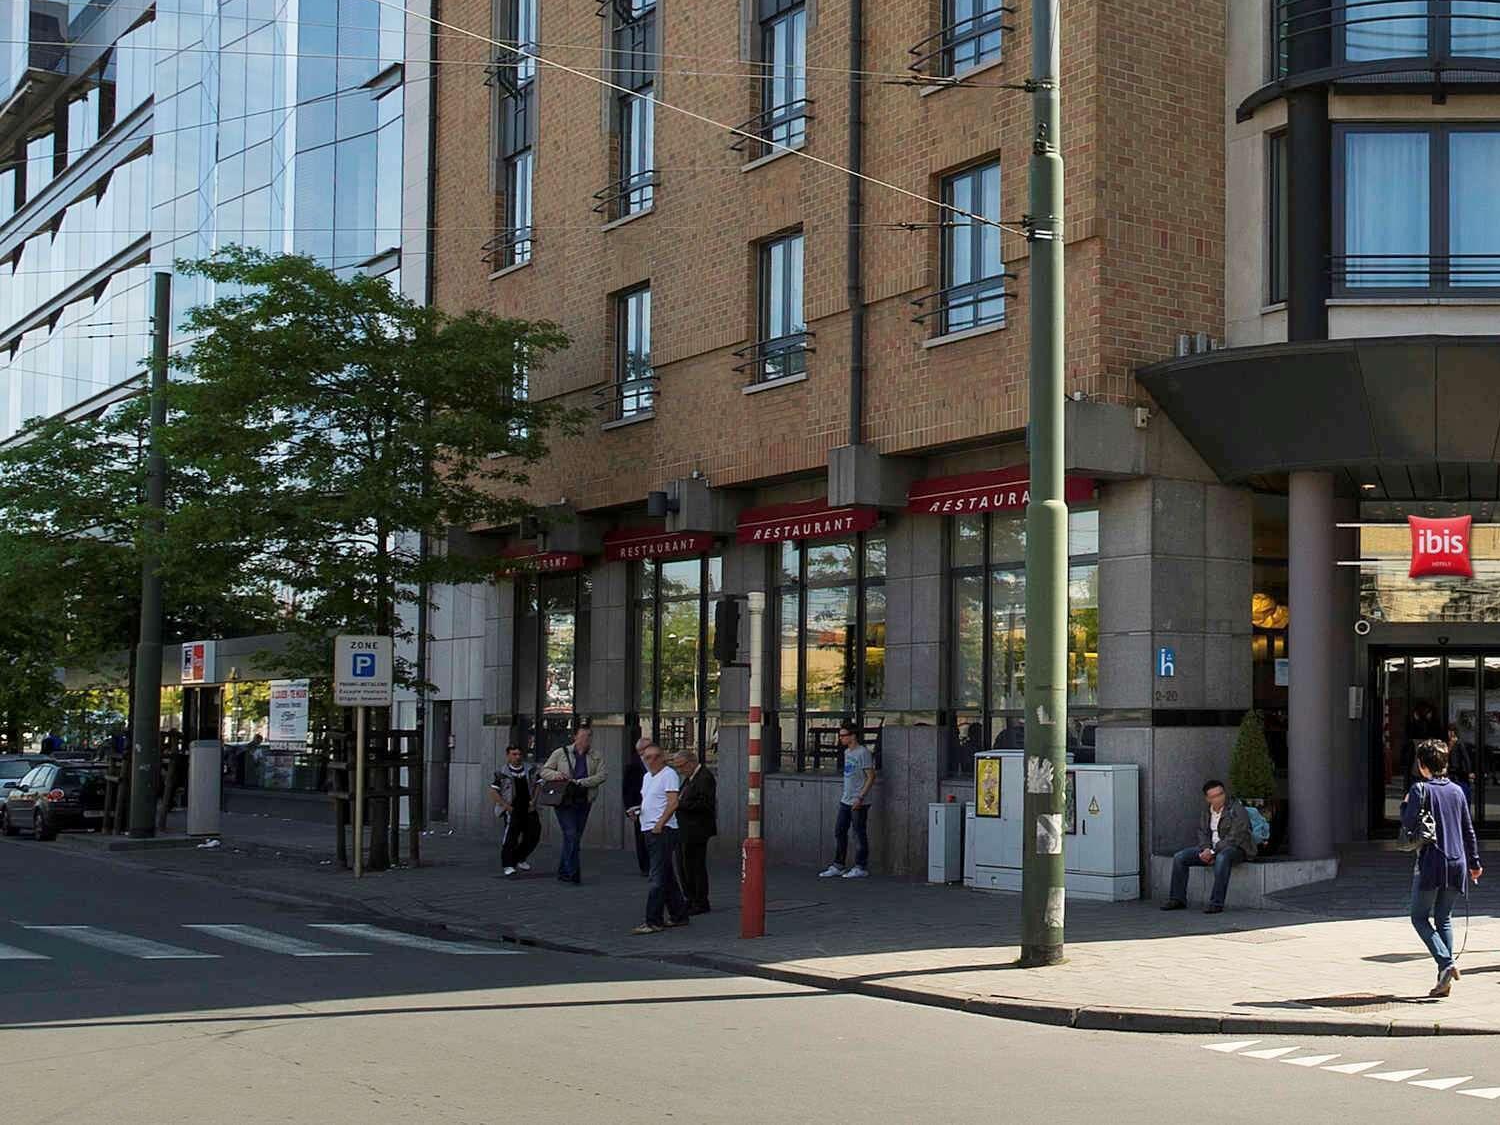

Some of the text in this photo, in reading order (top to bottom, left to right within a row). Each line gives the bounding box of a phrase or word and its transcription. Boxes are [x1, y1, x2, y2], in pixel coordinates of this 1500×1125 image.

[929, 489, 1031, 513] RESTAURA
[753, 517, 853, 540] RESTAURANT
[619, 538, 696, 558] RESTAURANT
[1418, 529, 1464, 554] ibis
[350, 641, 379, 650] ZONE
